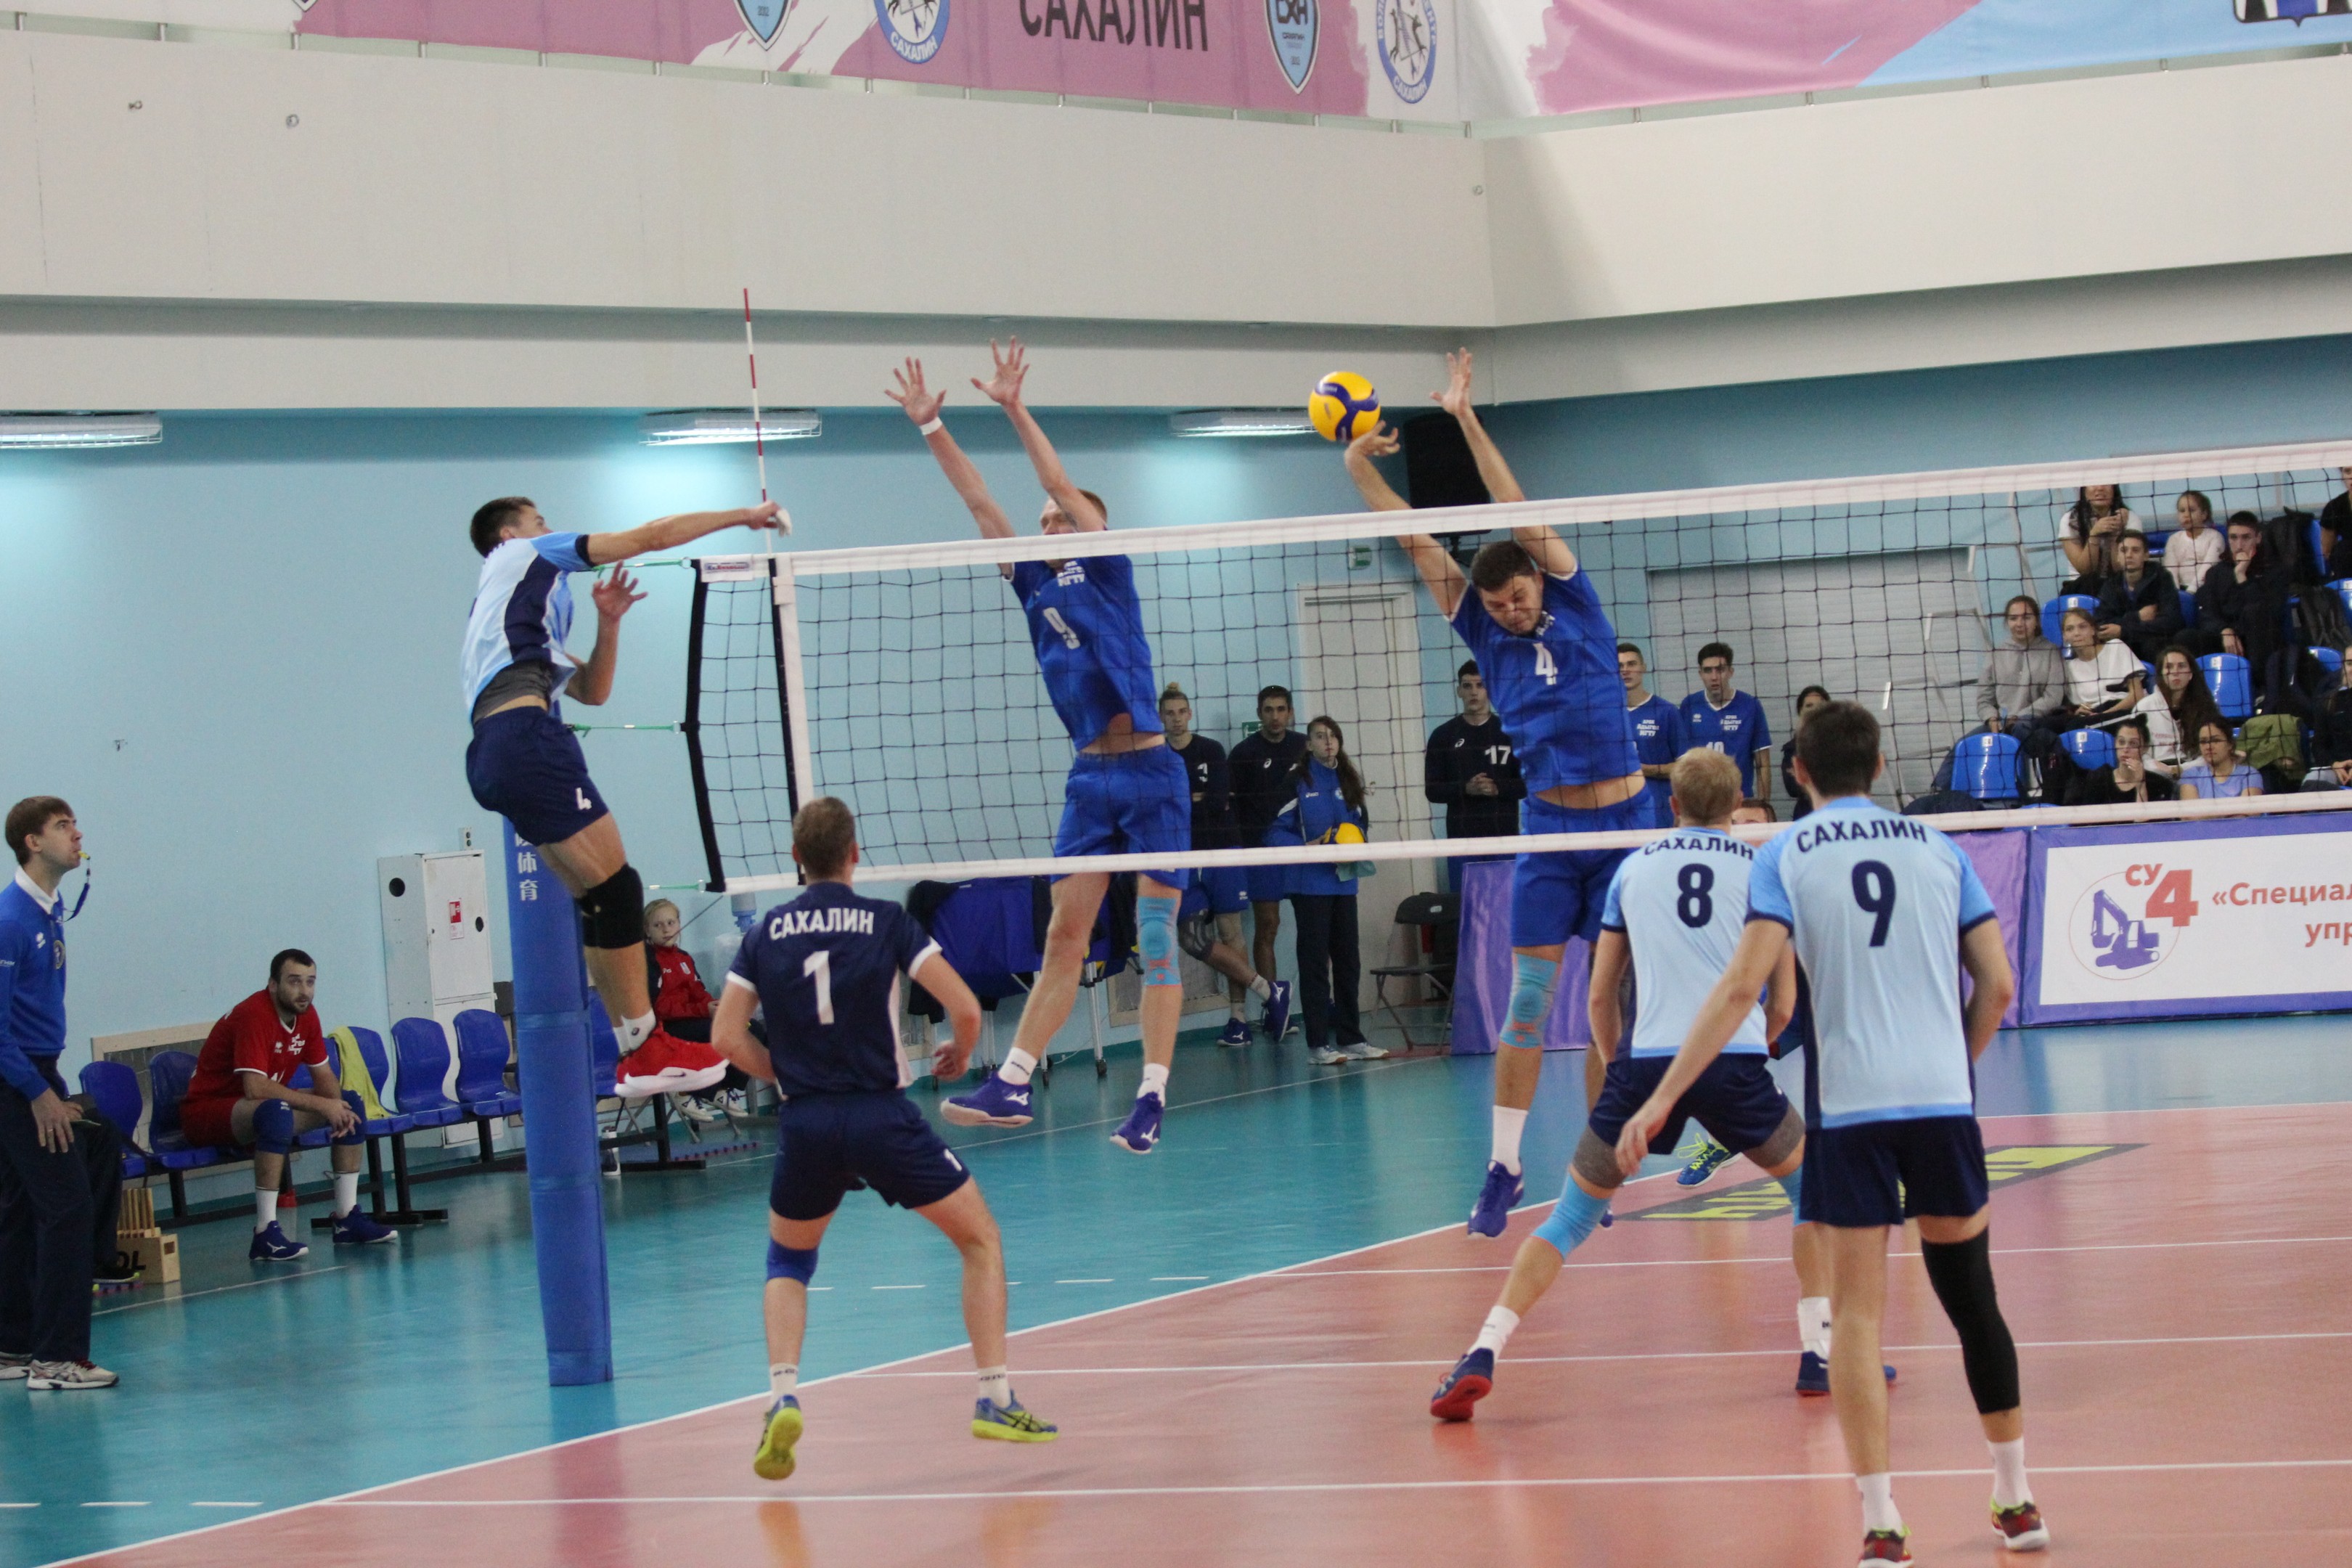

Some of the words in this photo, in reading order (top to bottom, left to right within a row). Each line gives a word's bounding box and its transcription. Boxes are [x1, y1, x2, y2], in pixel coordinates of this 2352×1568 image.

[890, 31, 939, 61] САХАЛИН
[1020, 0, 1208, 52] САХАЛИН
[1532, 642, 1559, 685] 4
[1485, 745, 1511, 764] 17
[1643, 836, 1754, 861] САХАЛИН
[1796, 819, 1929, 854] САХАЛИН
[1676, 862, 1715, 928] 8
[1851, 859, 1897, 947] 9
[2144, 869, 2199, 927] 4
[769, 907, 875, 942] САХАЛИН
[803, 950, 835, 1025] 1
